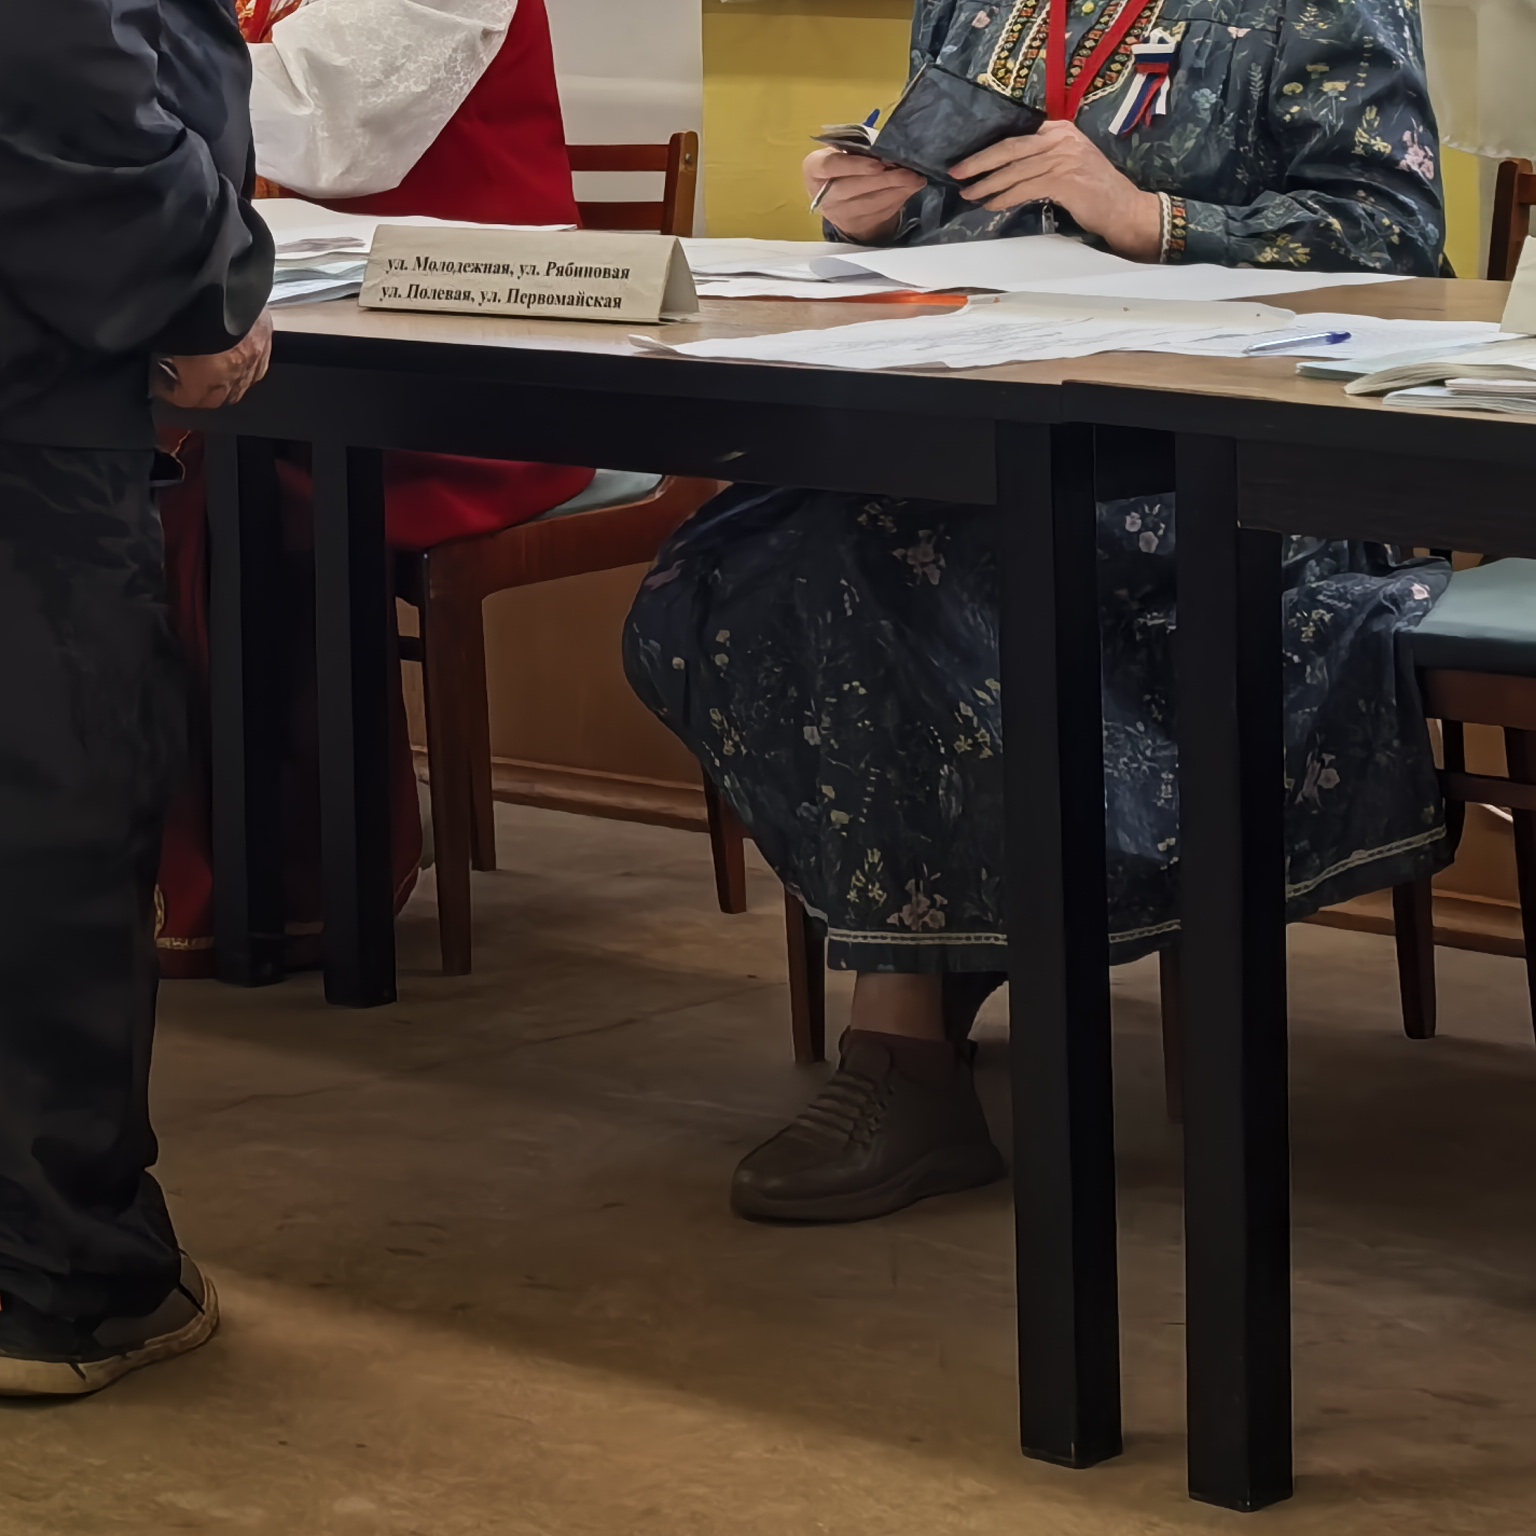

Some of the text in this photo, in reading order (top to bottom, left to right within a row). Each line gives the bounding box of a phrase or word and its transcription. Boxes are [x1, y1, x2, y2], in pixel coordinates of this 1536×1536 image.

[385, 255, 631, 281] ул. Молодежная, ул. Рябиновая
[379, 283, 624, 310] ул. Полевая, ул. Первомайская
